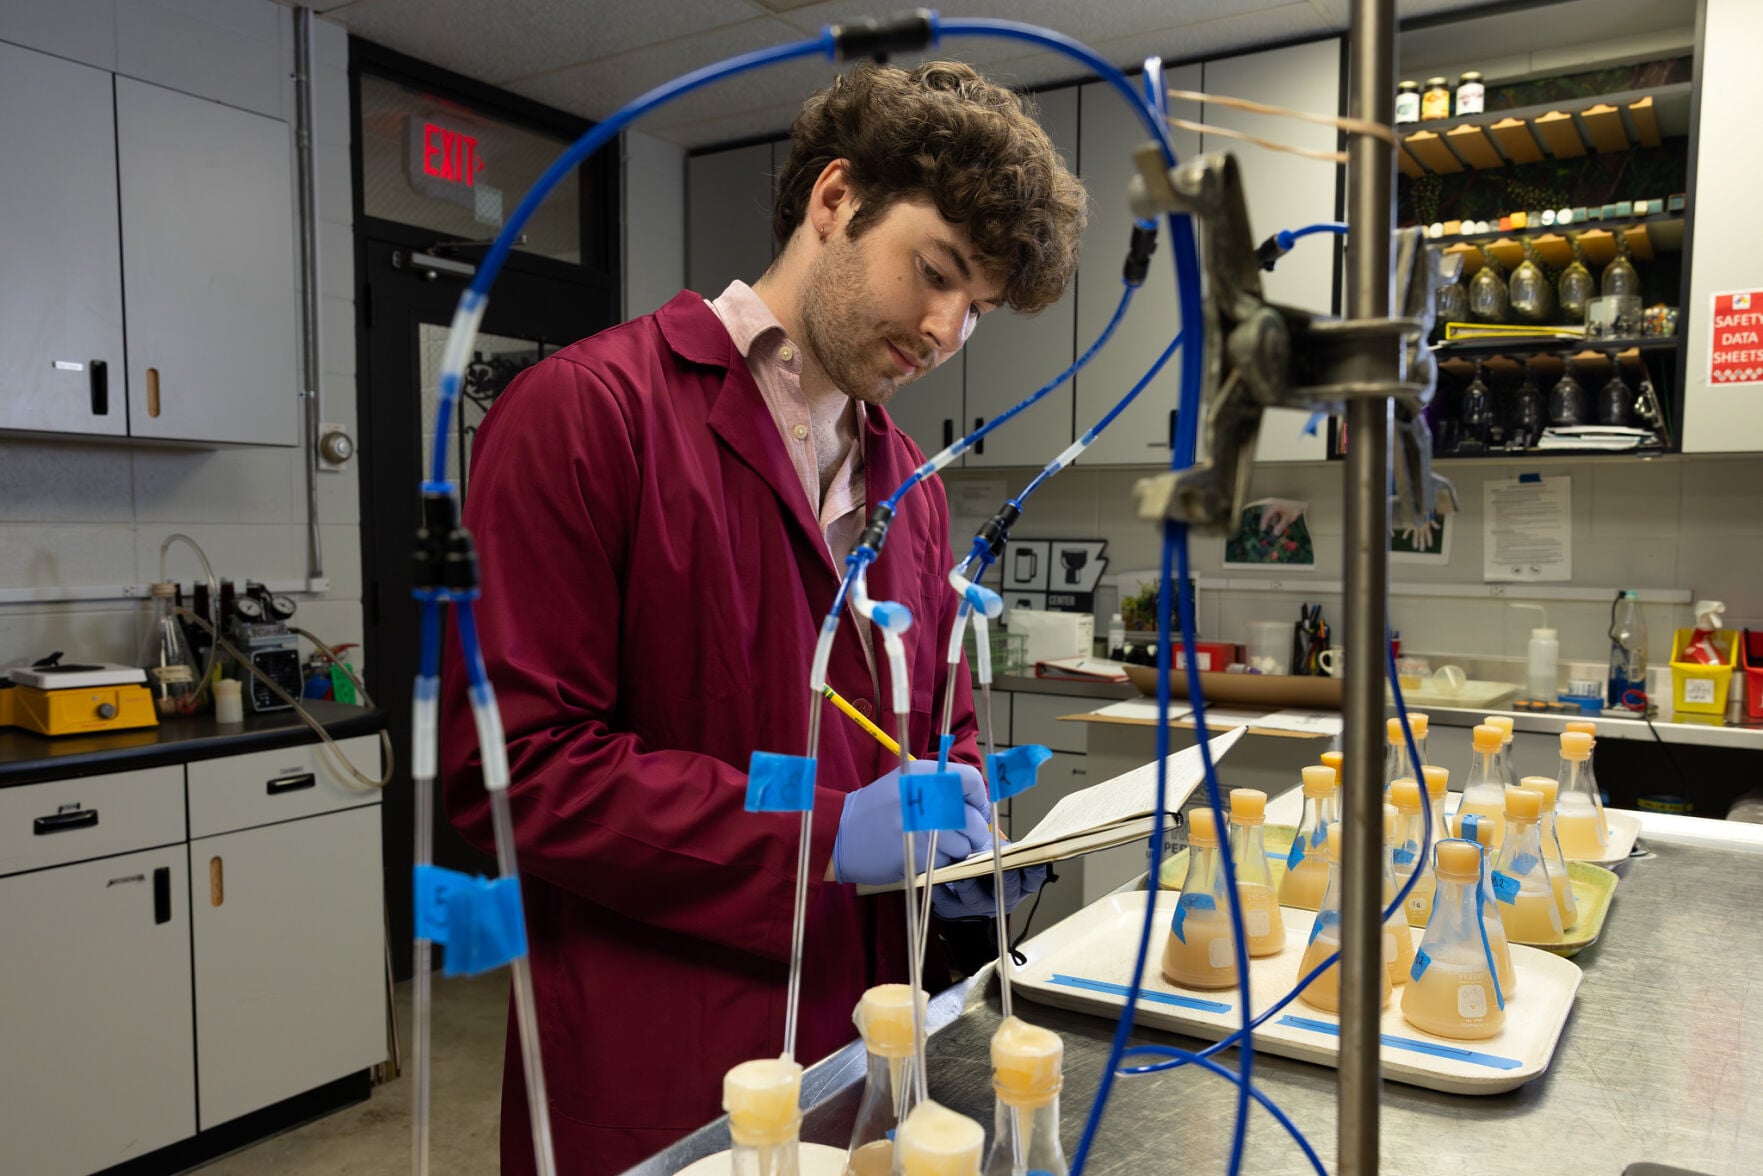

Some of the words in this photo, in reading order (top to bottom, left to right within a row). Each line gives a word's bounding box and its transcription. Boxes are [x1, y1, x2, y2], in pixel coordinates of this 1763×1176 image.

[424, 122, 478, 187] EXIT
[1722, 332, 1758, 346] DATA
[1713, 349, 1763, 364] SHEETS
[998, 762, 1011, 785] 2
